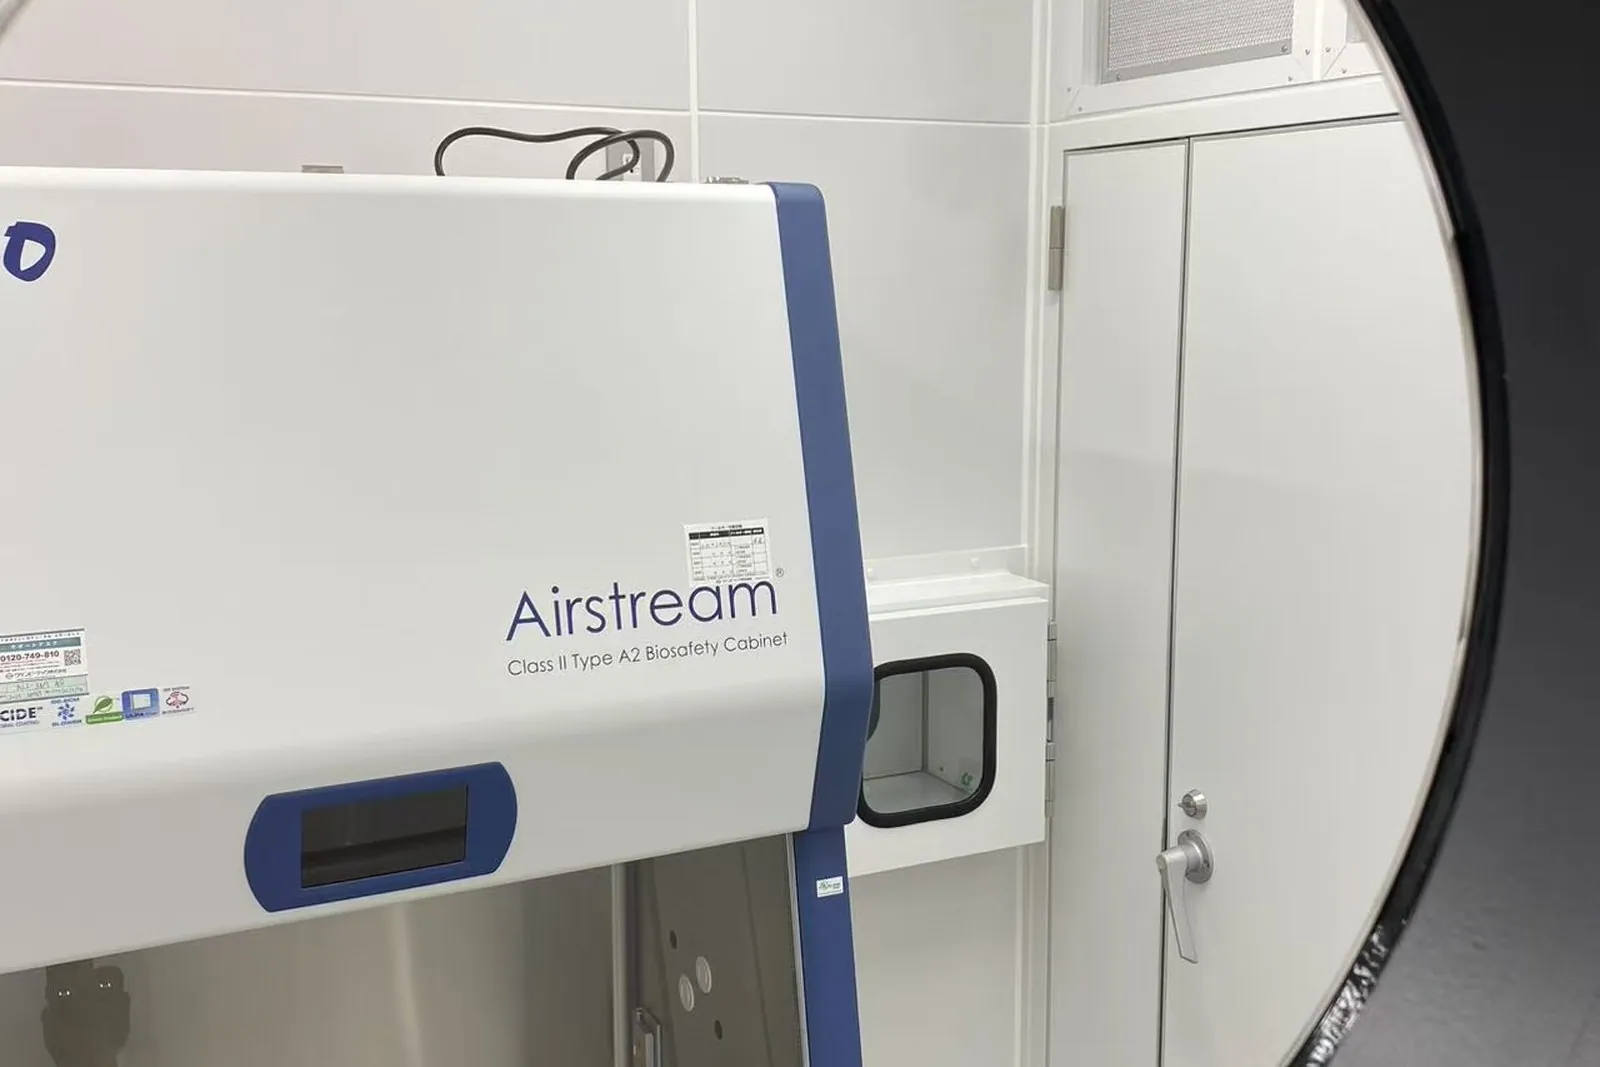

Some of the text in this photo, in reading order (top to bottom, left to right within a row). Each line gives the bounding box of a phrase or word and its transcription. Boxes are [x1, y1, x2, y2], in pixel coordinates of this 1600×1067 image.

[506, 580, 778, 641] Airstream
[0, 649, 60, 662] 0120-749-810
[507, 659, 554, 676] Class
[571, 653, 613, 671] Type
[619, 647, 641, 663] A2
[645, 640, 719, 661] Biosafety
[723, 631, 787, 652] Cabinet
